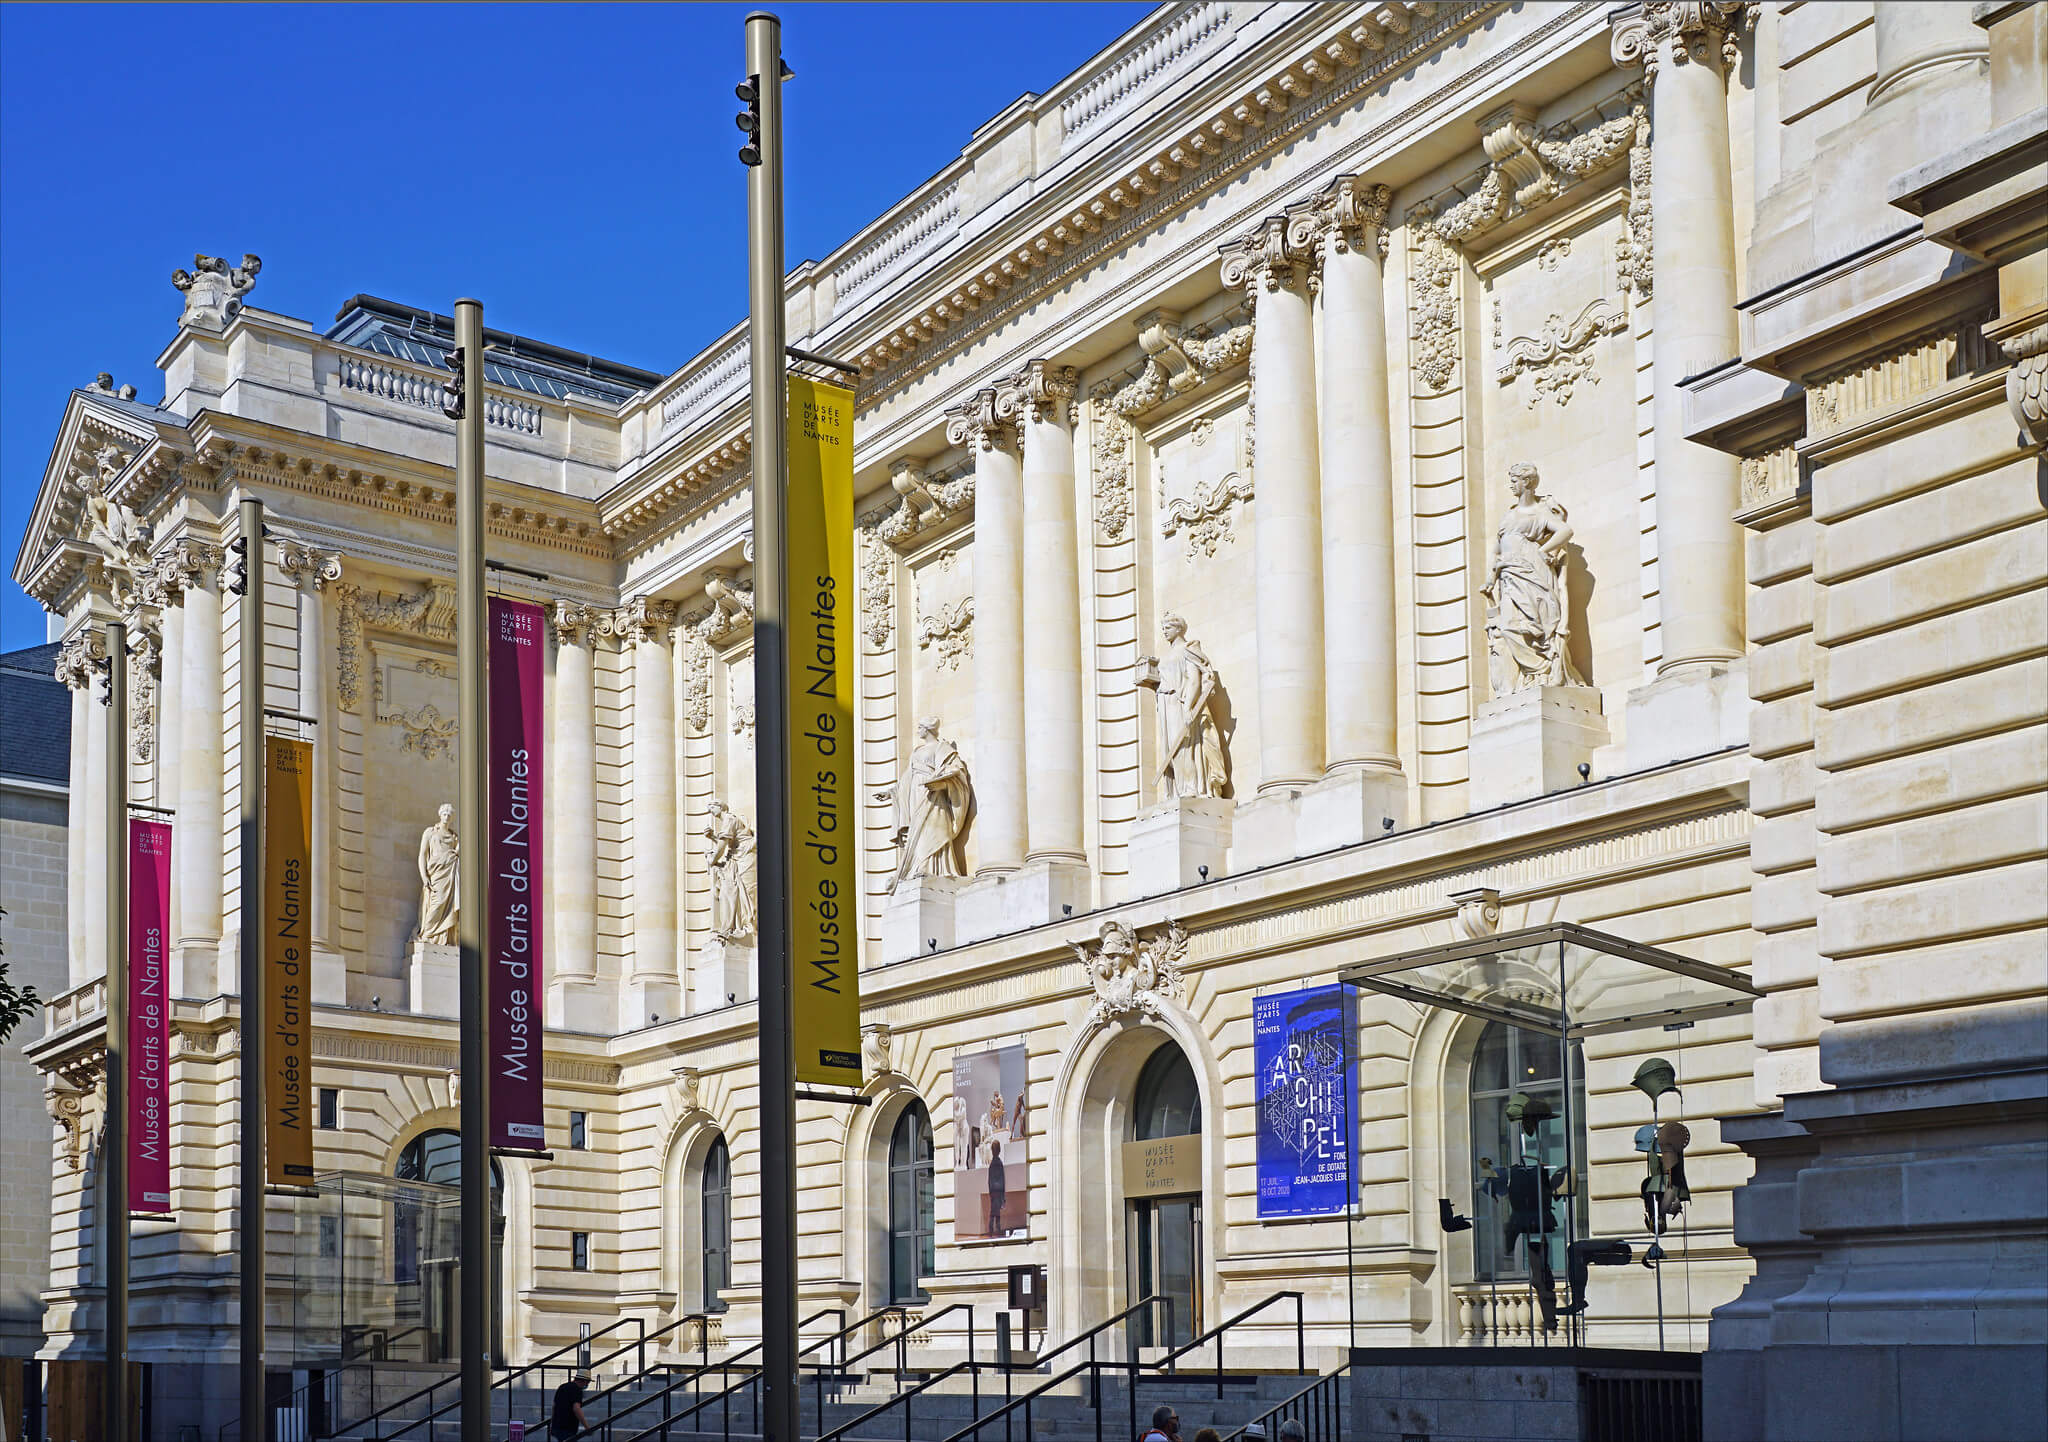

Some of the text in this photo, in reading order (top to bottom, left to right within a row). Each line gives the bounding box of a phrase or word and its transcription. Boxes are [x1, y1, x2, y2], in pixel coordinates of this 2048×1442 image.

[803, 401, 839, 417] MUSÉE
[803, 411, 839, 426] D'ARTS
[803, 421, 815, 429] DE
[803, 430, 839, 445] NANTES
[501, 611, 532, 624] MUSÉE
[501, 620, 532, 631] D'ARTS
[501, 634, 532, 646] NANTES
[804, 575, 840, 994] Musée d'arts de Nantes
[499, 748, 528, 1081] Musée d'arts de Nantes
[276, 858, 300, 1130] Musée d'arts de Nantes
[1257, 1000, 1280, 1012] MUSÉE
[1257, 1010, 1280, 1020] D'ARTS
[1257, 1020, 1265, 1028] DE
[1257, 1025, 1280, 1036] NANTES
[137, 928, 160, 1161] Musée d'arts de Nantes
[1318, 1164, 1326, 1173] DE
[1293, 1173, 1333, 1185] JEAN-JACQUES
